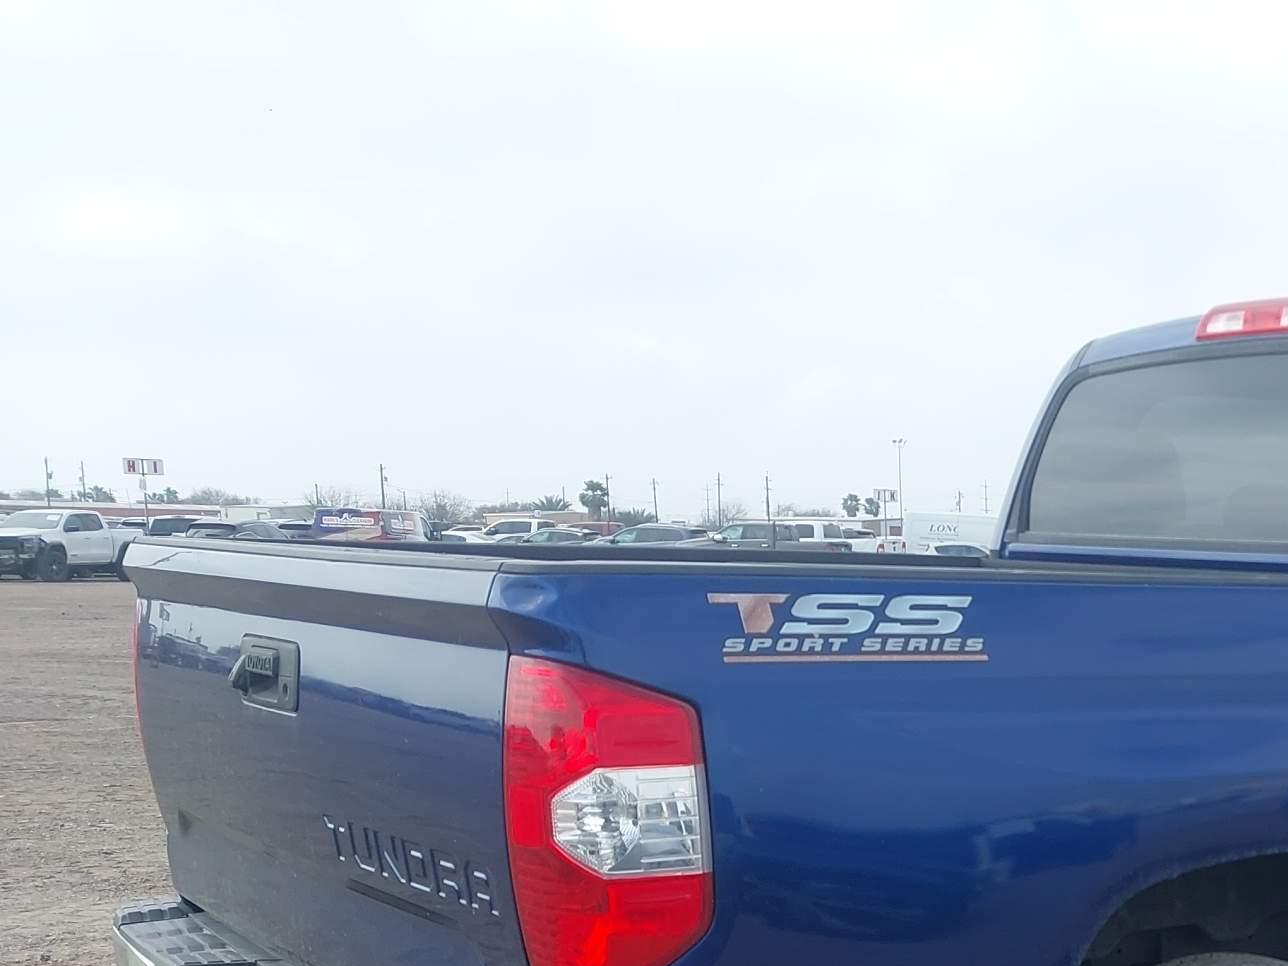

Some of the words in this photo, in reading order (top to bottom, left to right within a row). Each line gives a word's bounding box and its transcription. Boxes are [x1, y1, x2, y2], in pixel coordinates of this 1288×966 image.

[128, 460, 136, 472] H
[707, 593, 973, 635] TSS
[722, 637, 848, 652] SPORT
[861, 637, 985, 652] SERIES
[322, 813, 501, 918] TUNDRA
